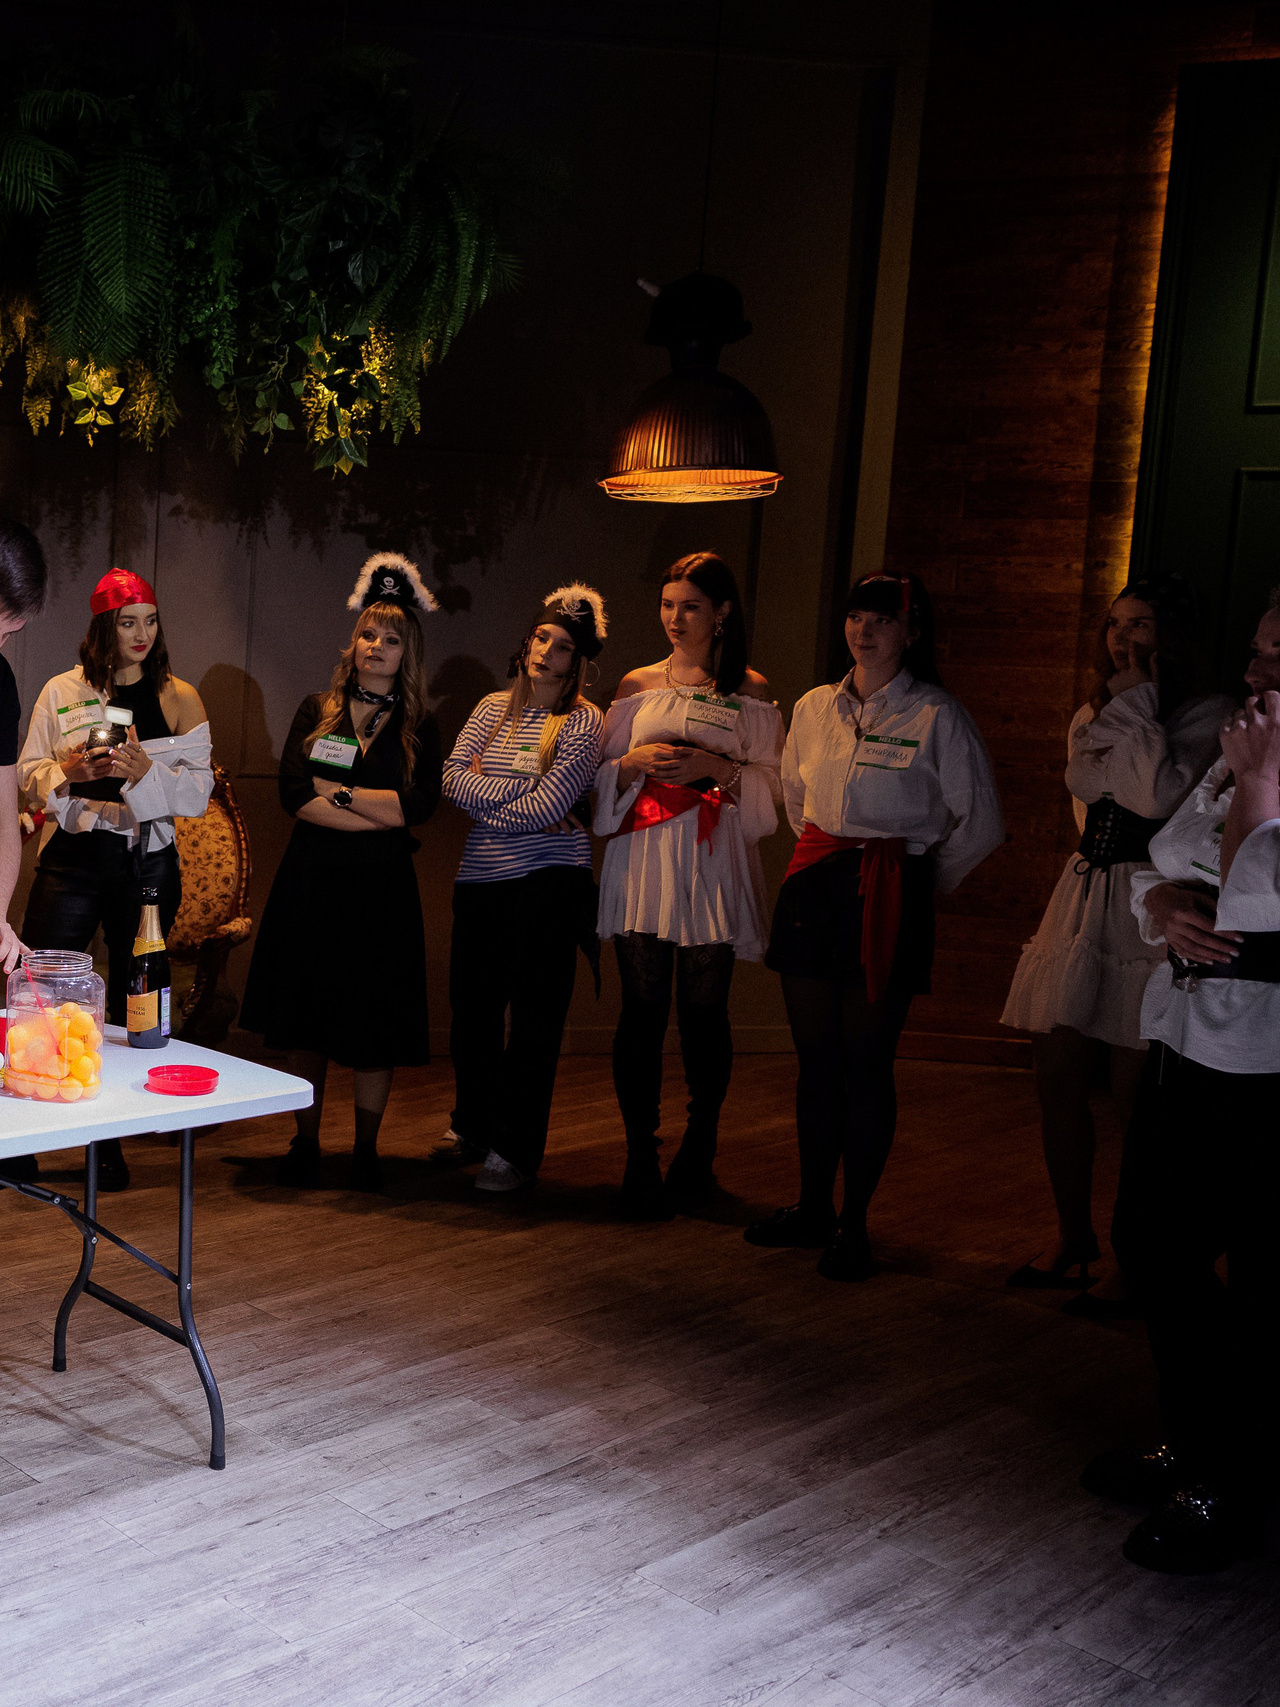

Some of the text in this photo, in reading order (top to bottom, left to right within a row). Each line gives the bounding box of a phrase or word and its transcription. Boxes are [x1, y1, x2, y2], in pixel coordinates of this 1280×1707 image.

[67, 701, 86, 711] HELLO
[705, 696, 726, 706] HELLO
[698, 711, 728, 726] ДОЧКА
[327, 734, 346, 743] HELLO
[878, 736, 902, 745] HELLO
